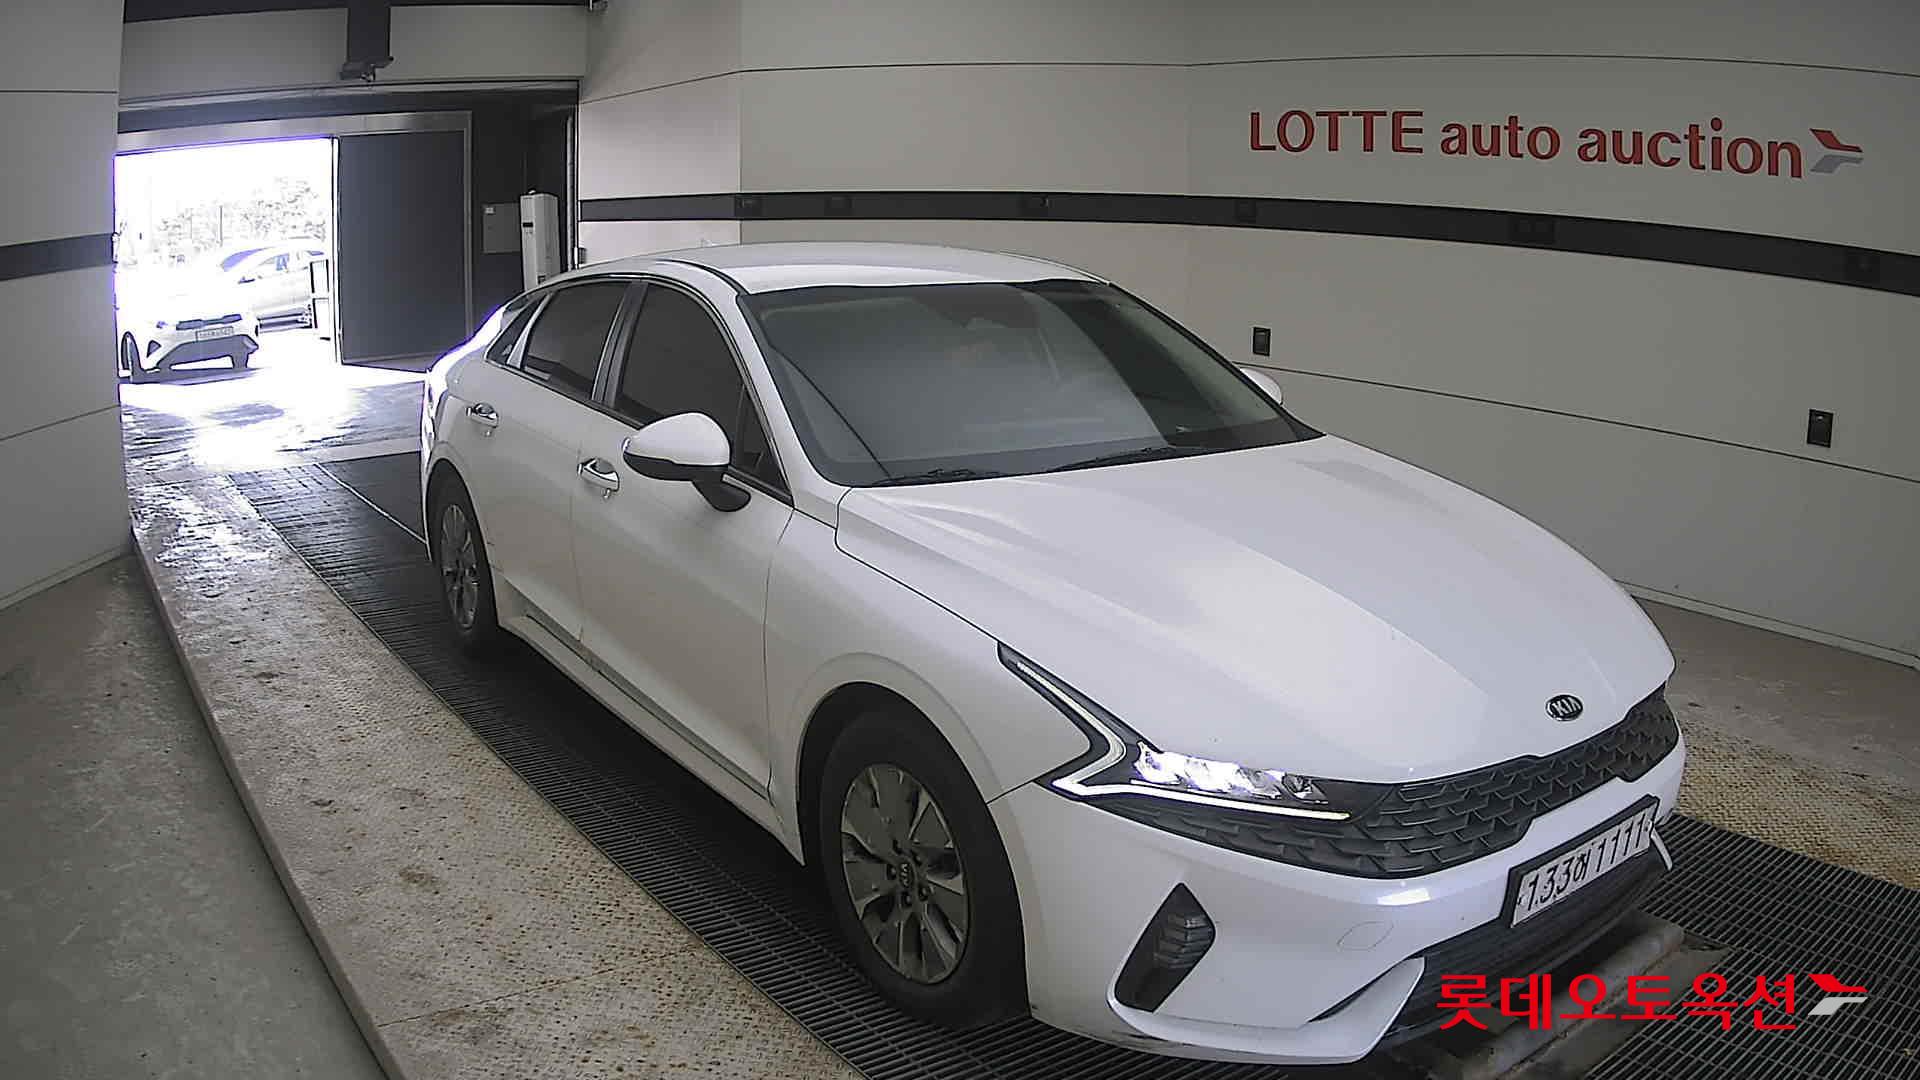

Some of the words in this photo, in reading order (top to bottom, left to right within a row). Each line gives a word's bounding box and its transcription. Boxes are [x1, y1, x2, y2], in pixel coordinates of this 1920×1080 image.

[1249, 110, 1424, 154] LOTTE
[1440, 115, 1562, 161] auto
[1576, 117, 1802, 179] auction
[1550, 696, 1582, 717] KIA
